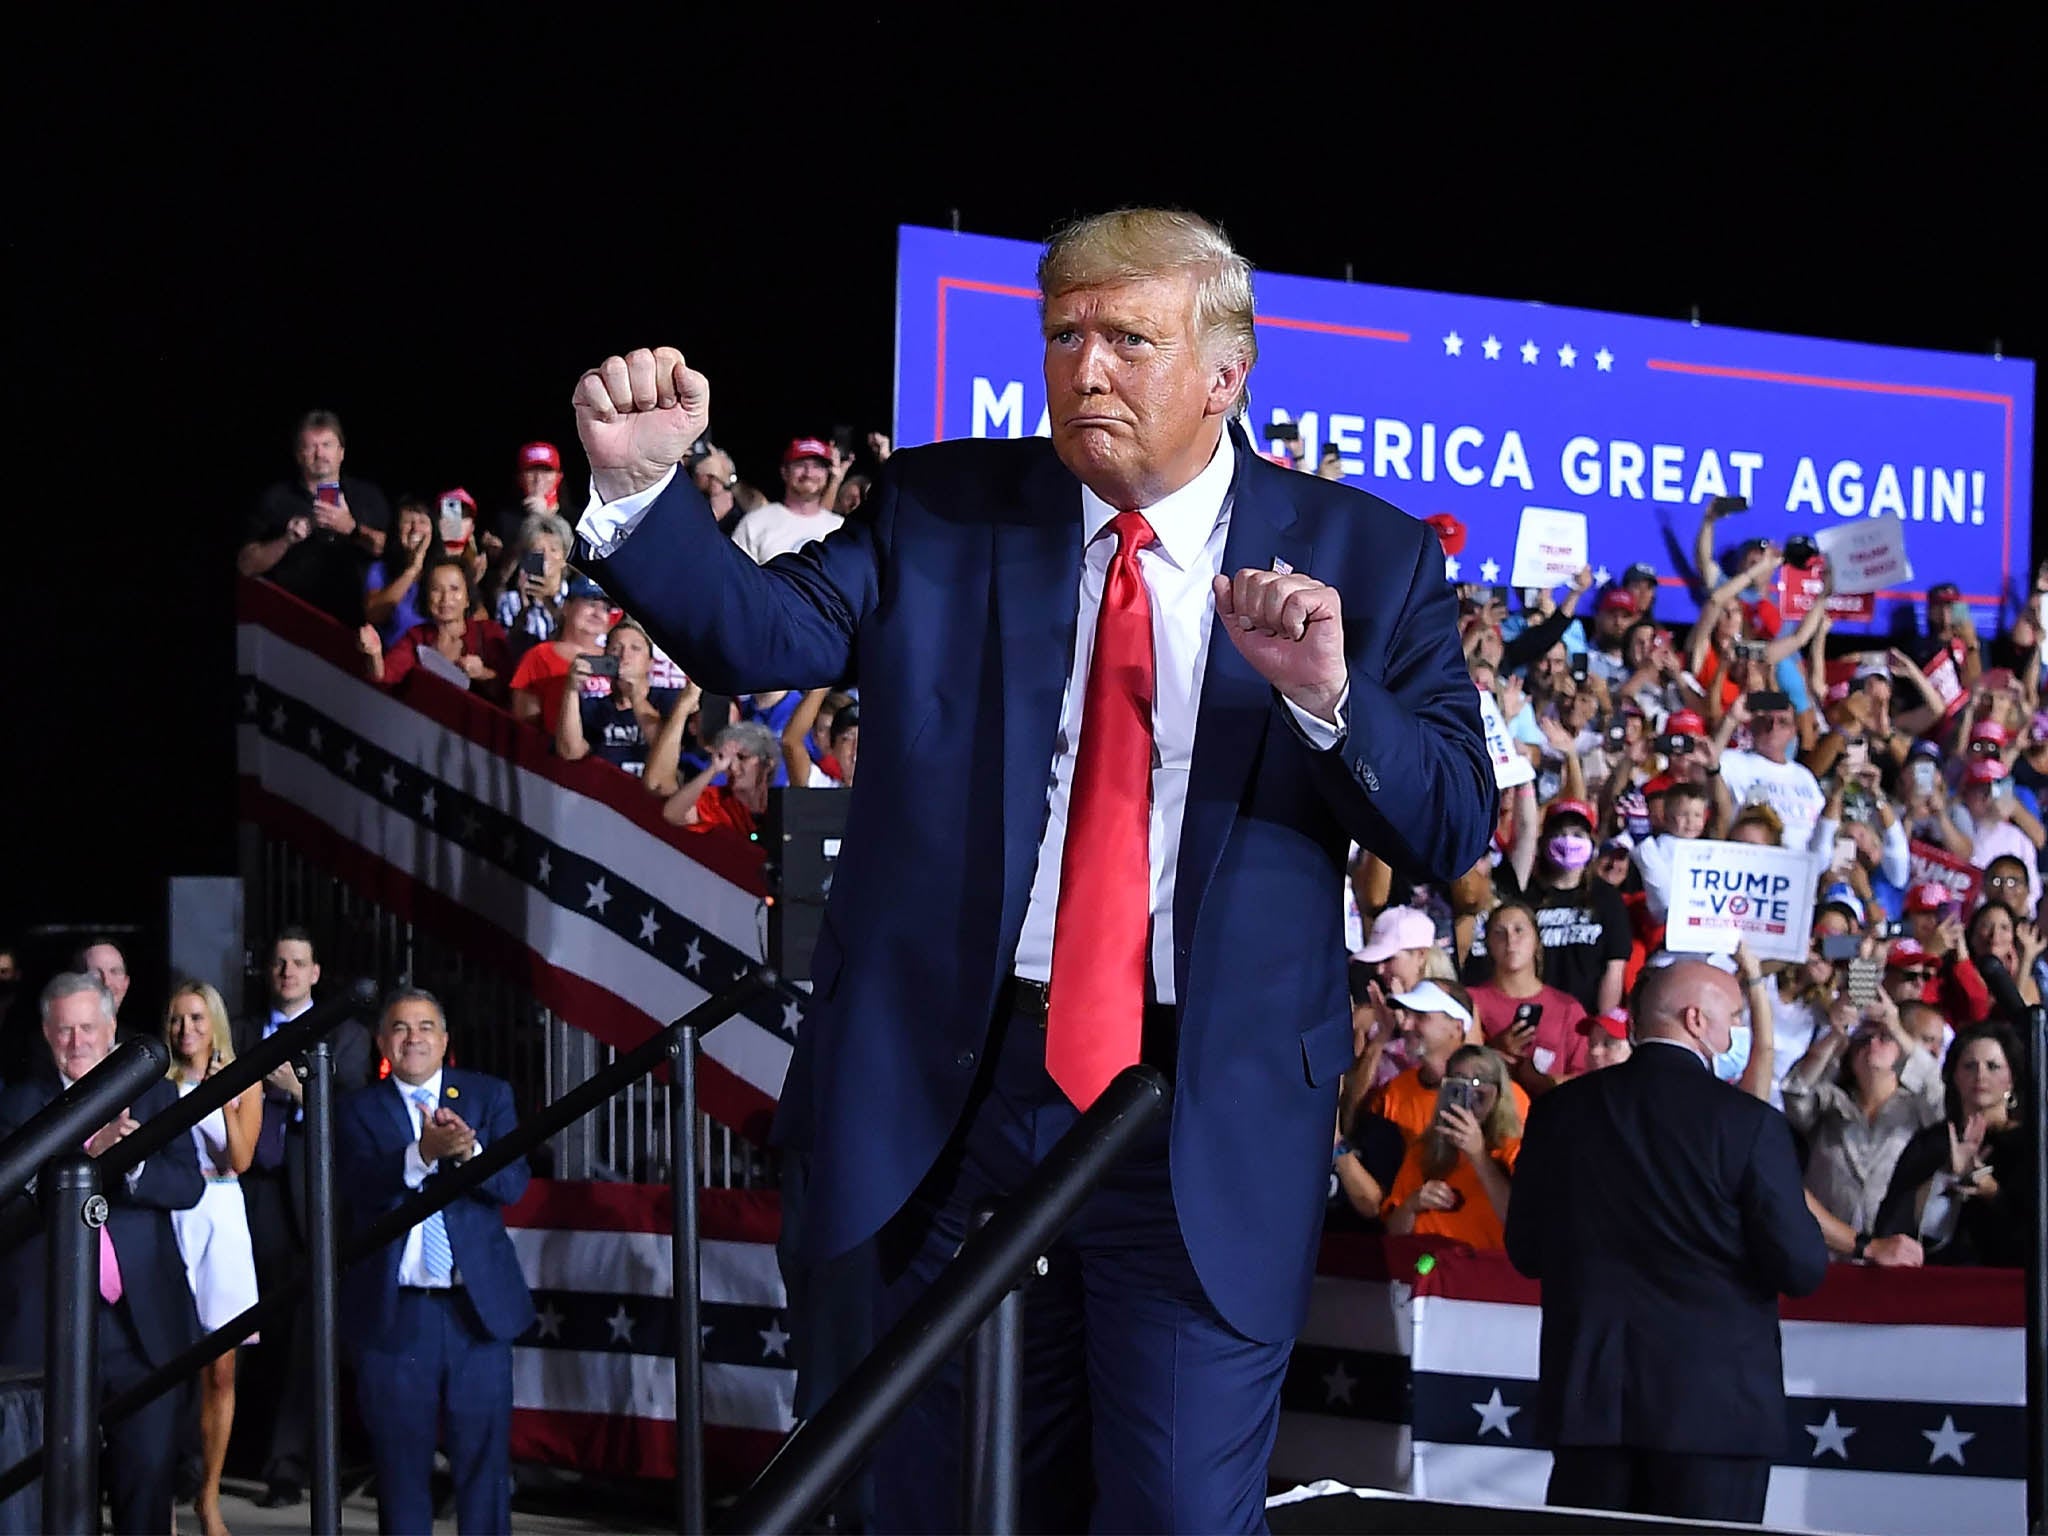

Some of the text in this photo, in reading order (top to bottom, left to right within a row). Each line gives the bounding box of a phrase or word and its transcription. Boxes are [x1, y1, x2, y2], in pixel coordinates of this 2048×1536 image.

[1239, 407, 1985, 525] MERICA GREAT AGAIN!
[1690, 869, 1790, 896] TRUMP
[1711, 894, 1788, 921] VOTE
